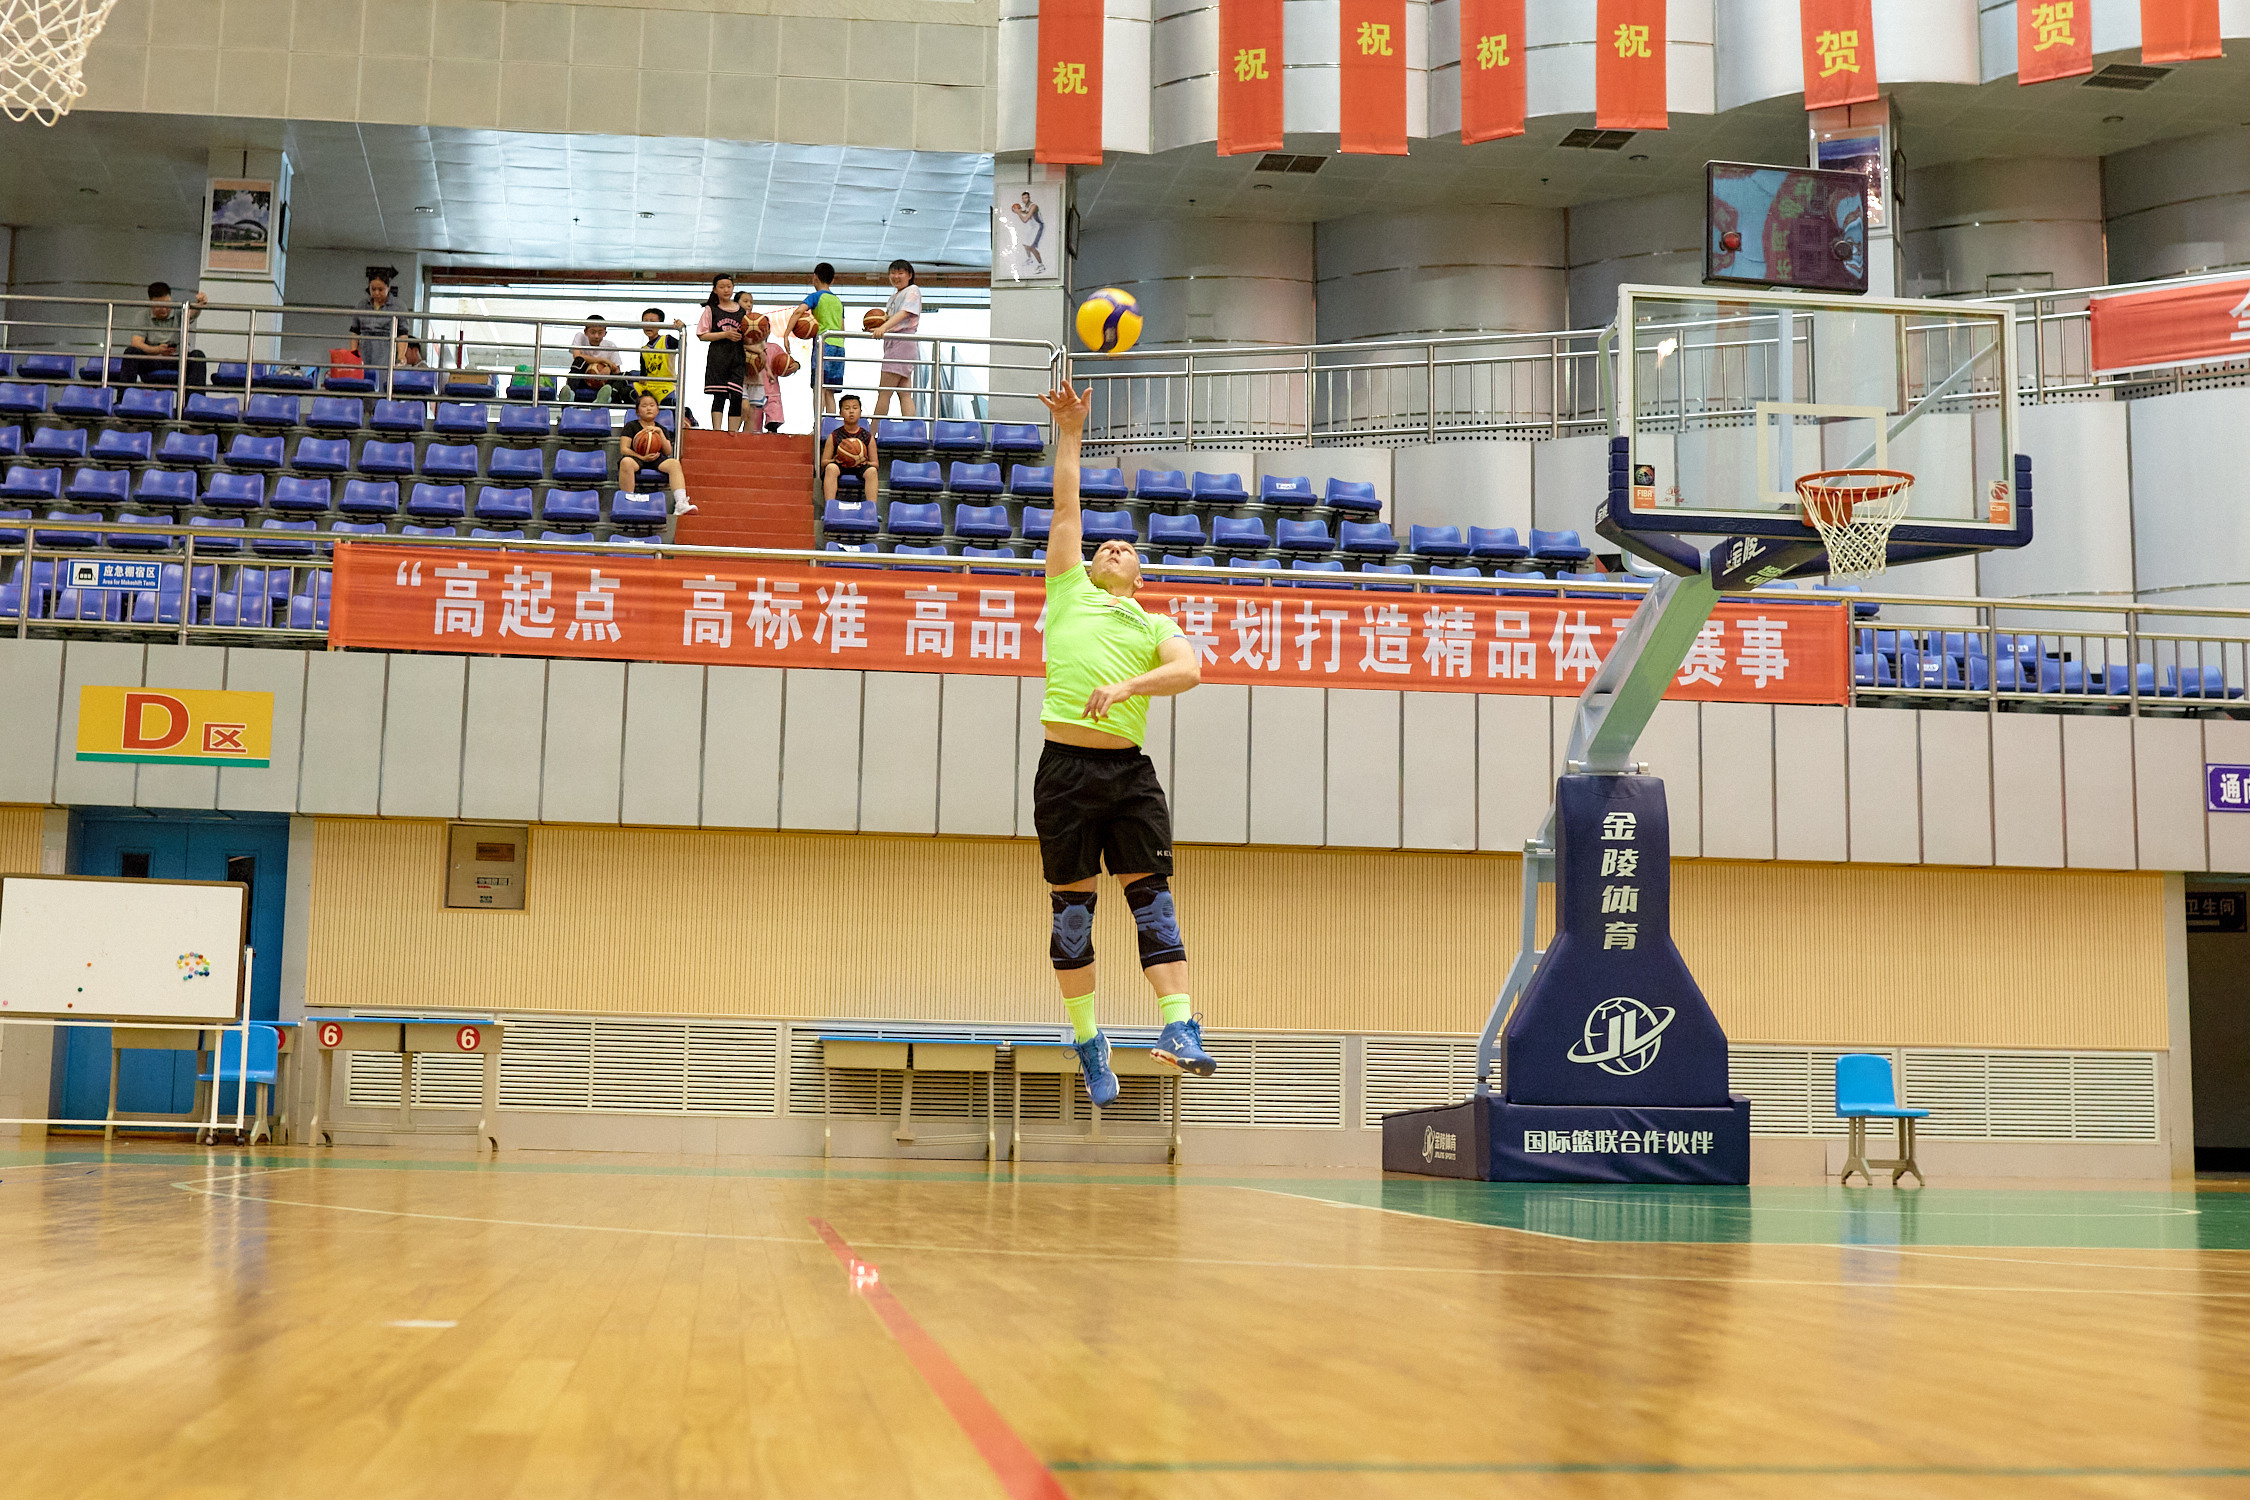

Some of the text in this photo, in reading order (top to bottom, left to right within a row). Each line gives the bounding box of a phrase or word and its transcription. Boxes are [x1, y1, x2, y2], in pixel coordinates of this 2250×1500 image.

[1357, 22, 1393, 57] 祝
[1613, 23, 1652, 59] 祝
[2031, 1, 2076, 52] 贺
[1234, 48, 1269, 82] 祝
[1476, 34, 1510, 70] 祝
[1815, 30, 1861, 78] 贺
[1053, 61, 1088, 95] 祝
[1637, 488, 1653, 498] FIBA
[103, 564, 156, 578] 应急棚宿区
[682, 574, 869, 654] 高标准
[904, 584, 1047, 662] 高品
[1167, 596, 1790, 689] 谋划打造精品体赛事
[1600, 811, 1640, 950] 金陵体育
[2187, 898, 2235, 916] 卫生间
[323, 1024, 339, 1045] 6
[461, 1028, 476, 1049] 6
[1523, 1129, 1714, 1155] 国际篮联合作伙伴
